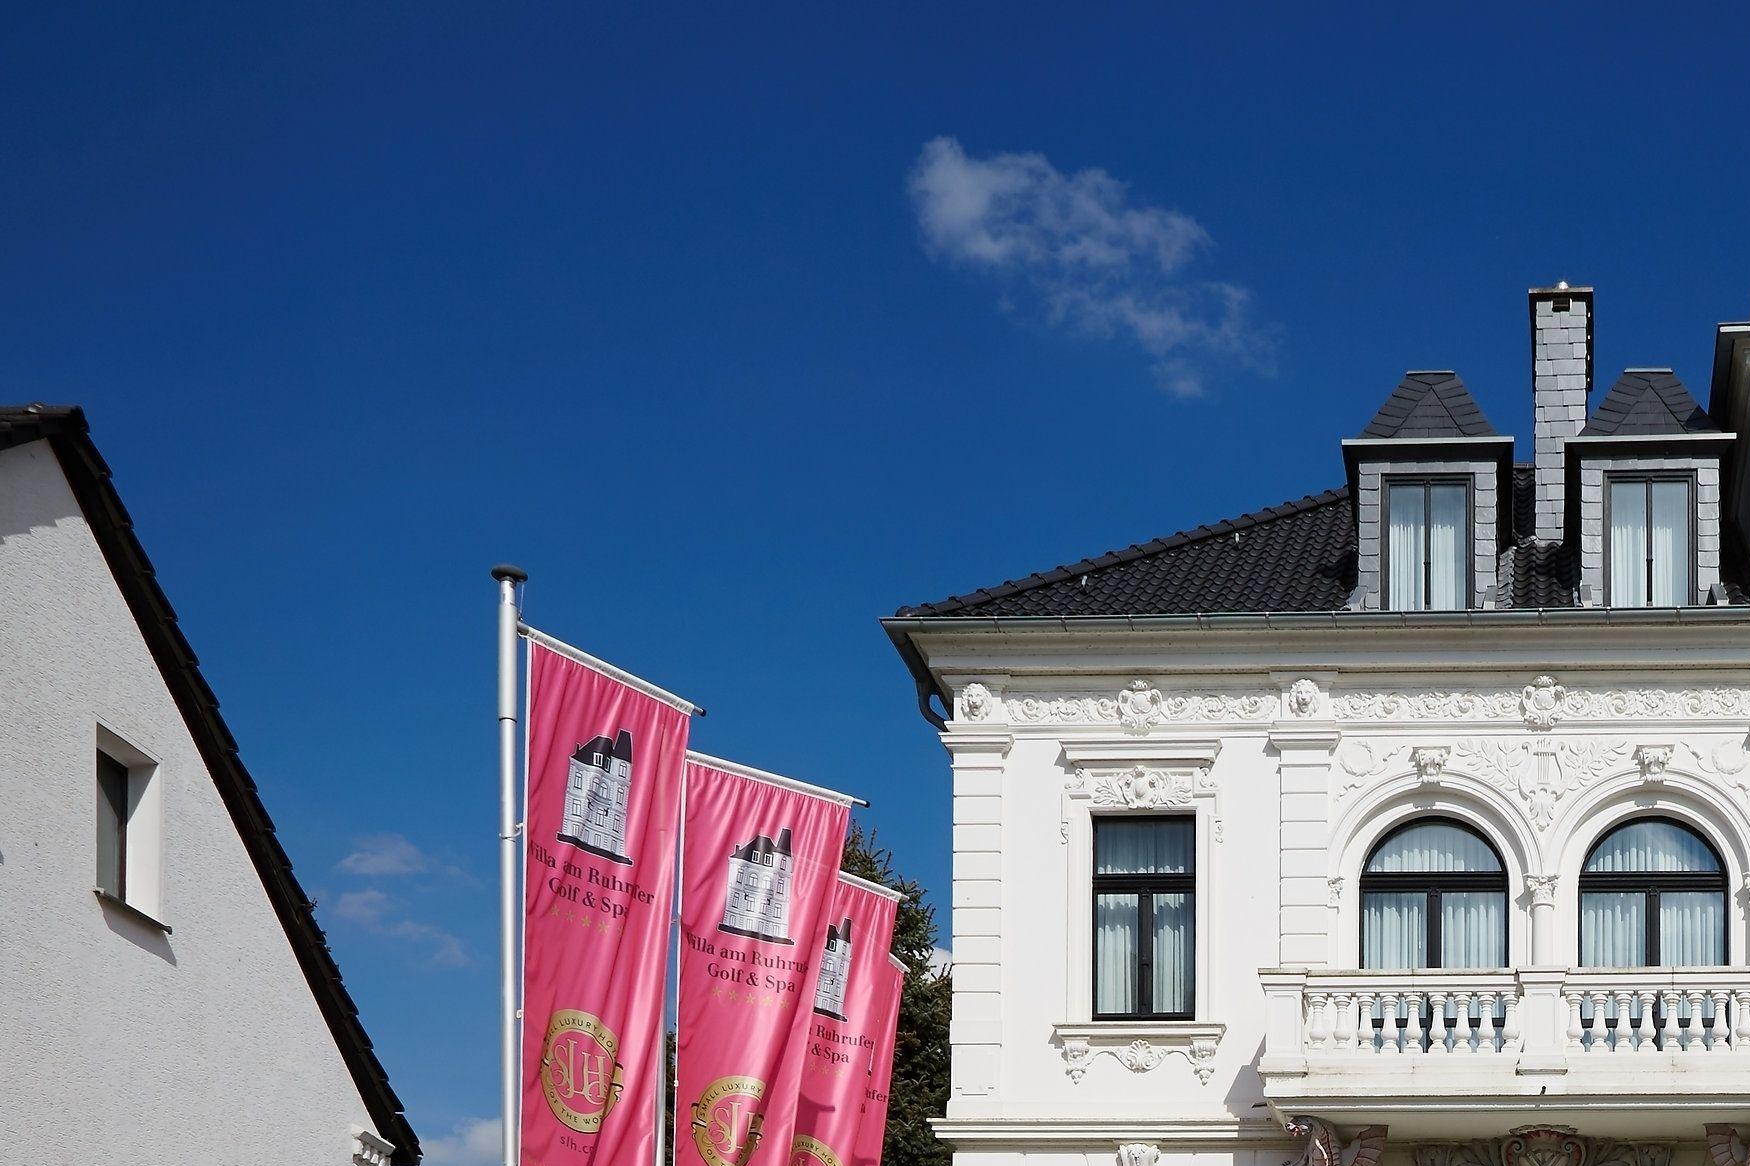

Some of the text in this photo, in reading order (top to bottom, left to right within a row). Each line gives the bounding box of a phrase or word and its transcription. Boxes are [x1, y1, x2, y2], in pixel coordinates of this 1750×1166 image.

[563, 860, 581, 879] am
[548, 877, 580, 902] Golf
[582, 891, 597, 908] &
[720, 947, 746, 962] am
[707, 962, 796, 993] Golf & Spa
[559, 1017, 597, 1031] LUXURY
[811, 1043, 849, 1064] & Spa
[700, 1083, 762, 1116] SMALL LUXURY
[561, 1108, 578, 1123] THE
[707, 1149, 716, 1160] OF
